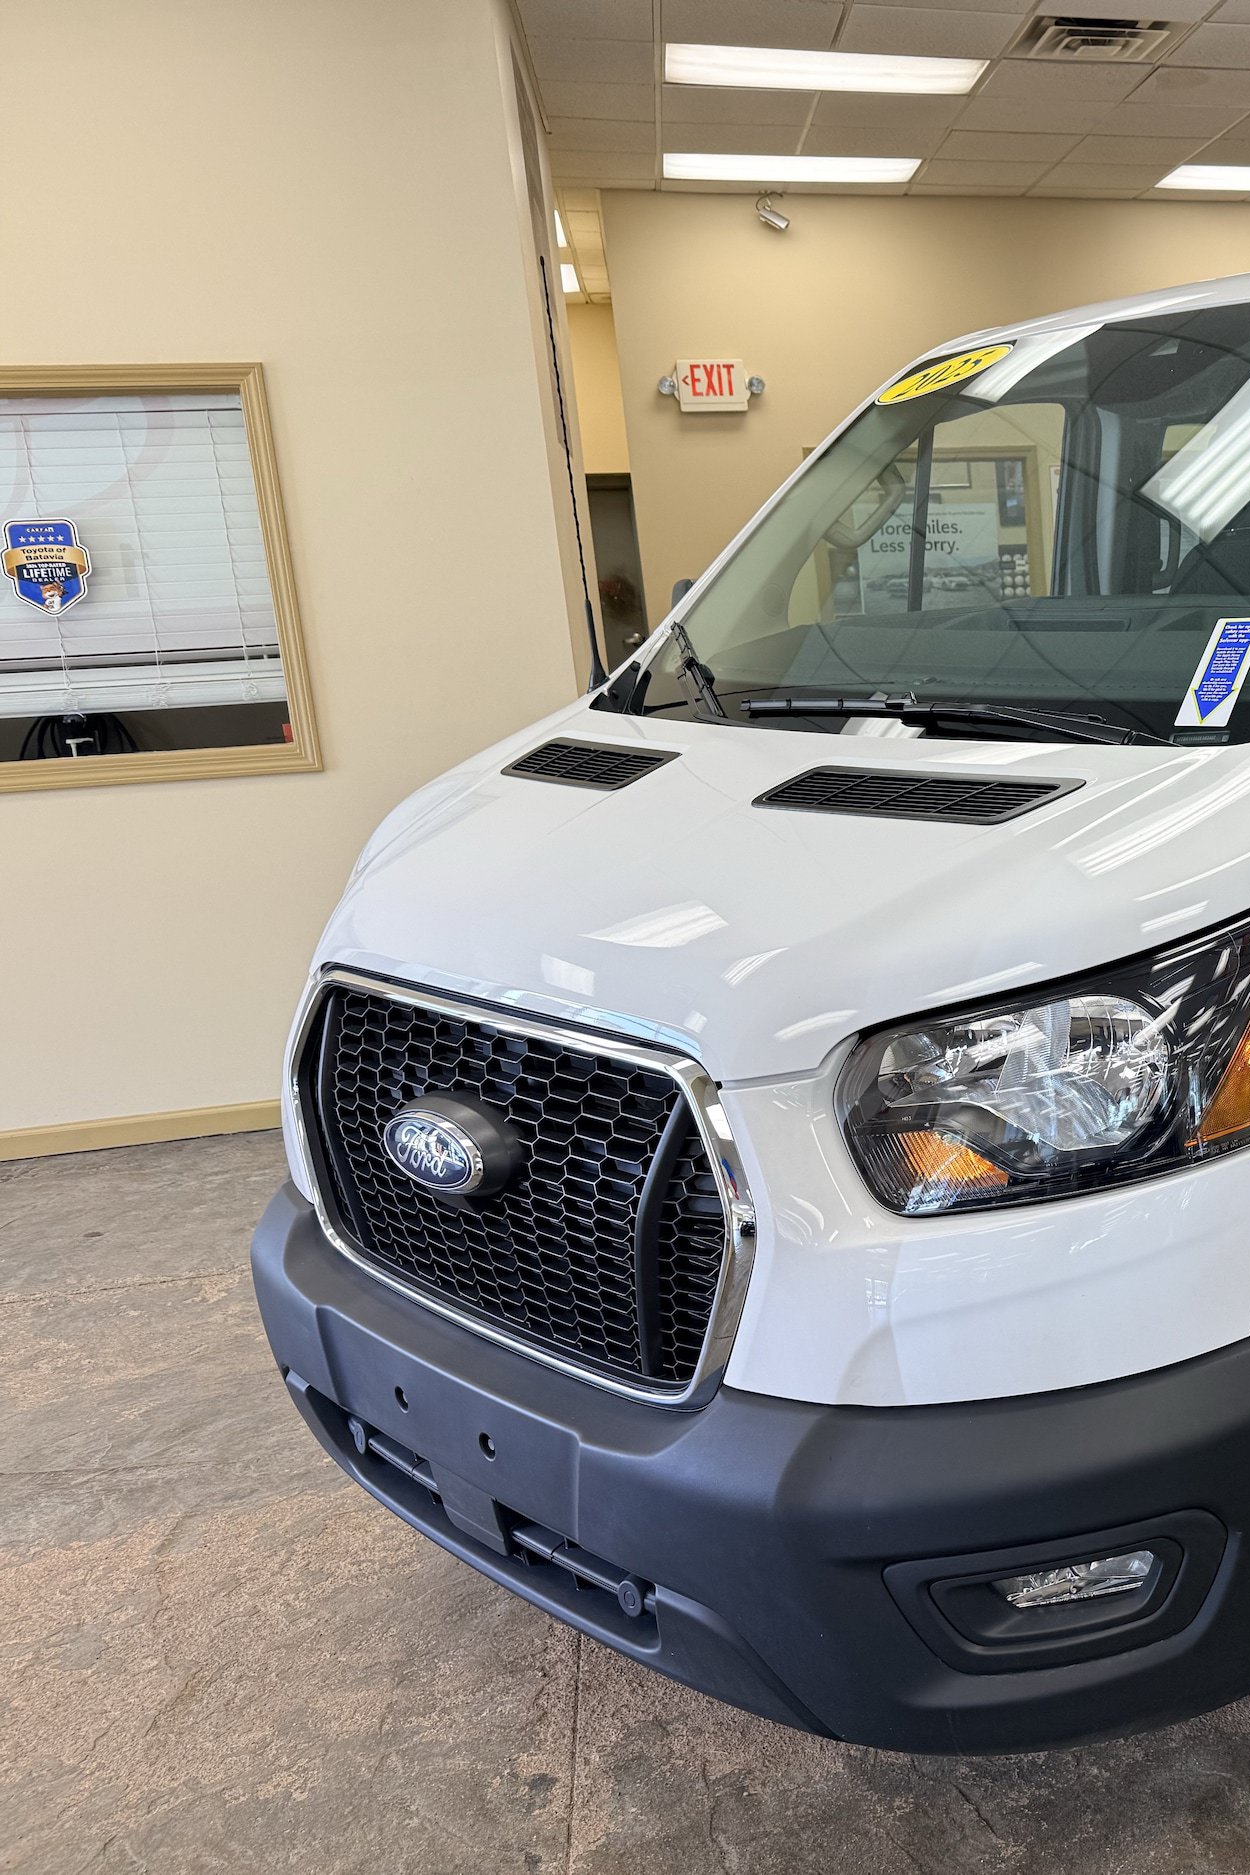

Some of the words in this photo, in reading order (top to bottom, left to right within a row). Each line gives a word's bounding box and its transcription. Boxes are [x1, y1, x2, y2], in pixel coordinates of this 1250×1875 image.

[689, 364, 734, 396] EXIT
[890, 349, 997, 400] 2025
[22, 547, 54, 555] Toyota
[870, 539, 905, 553] Less
[25, 553, 64, 561] Batavia
[22, 567, 72, 578] LIFETIME
[396, 1125, 448, 1178] Ford
